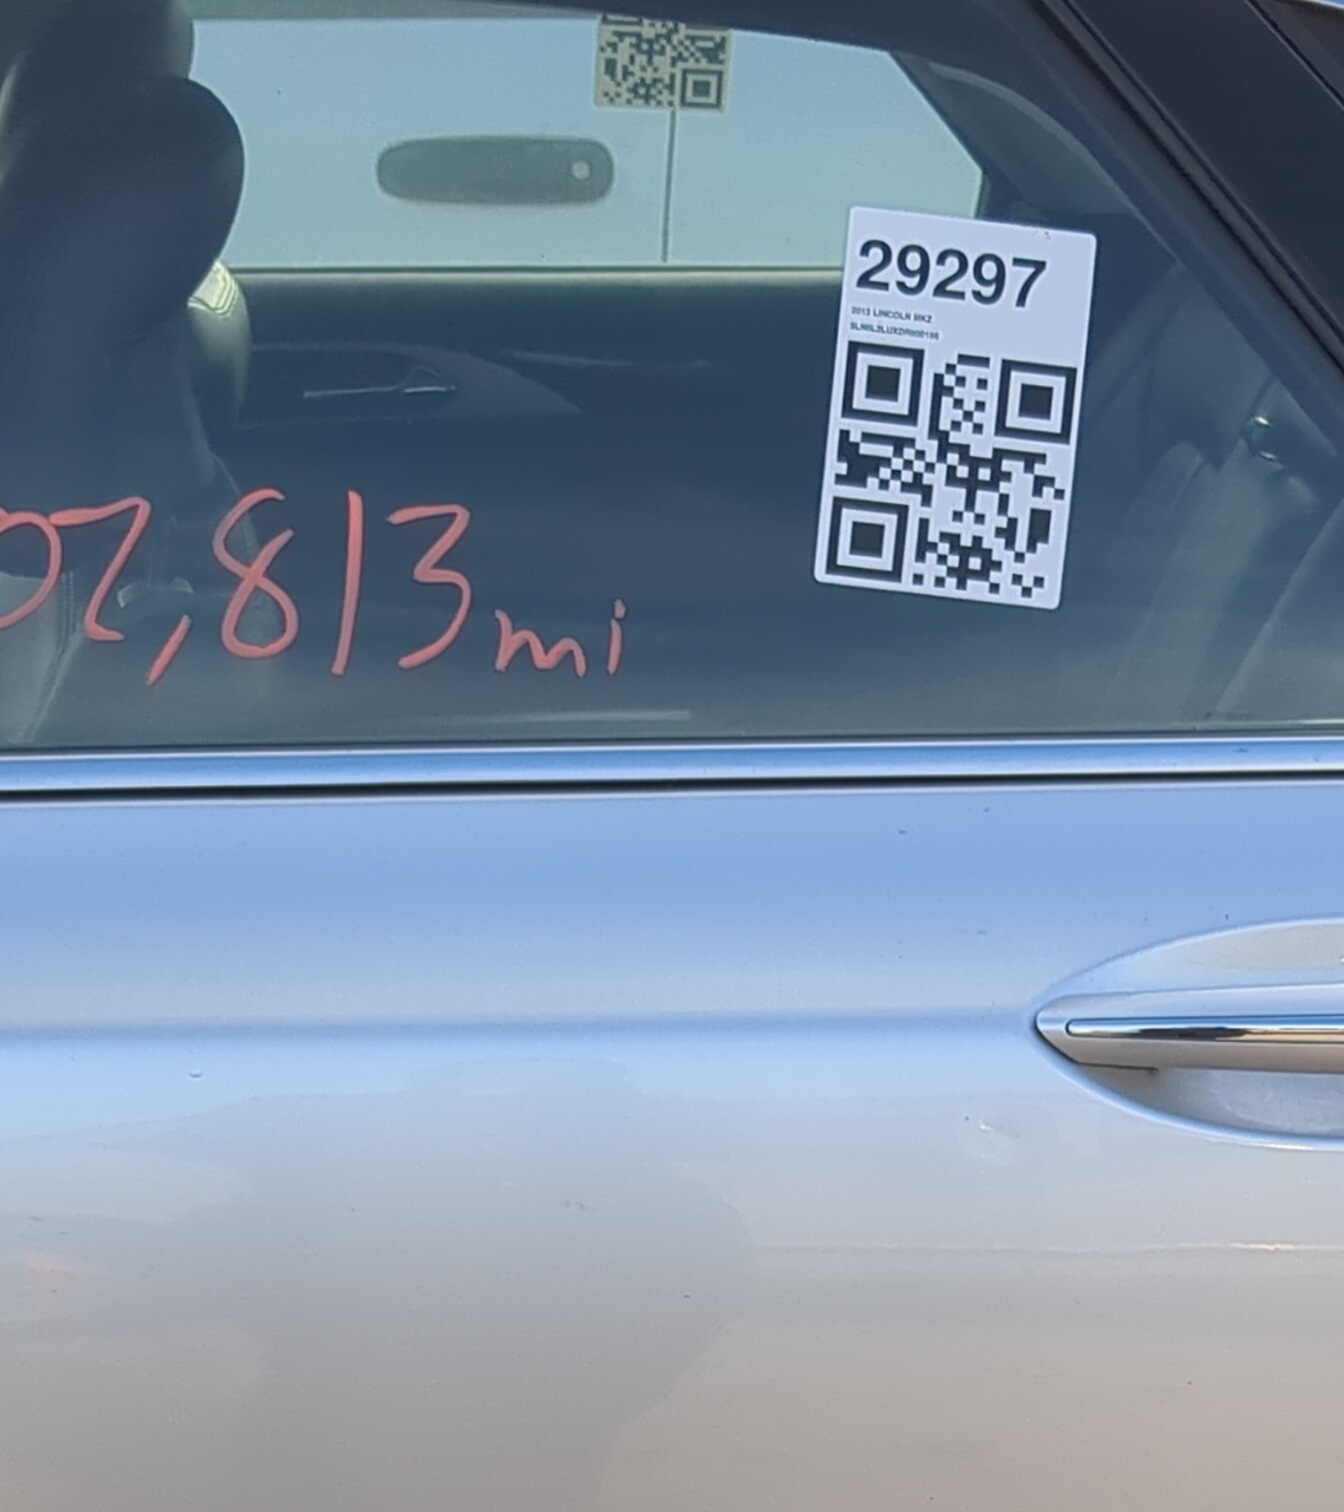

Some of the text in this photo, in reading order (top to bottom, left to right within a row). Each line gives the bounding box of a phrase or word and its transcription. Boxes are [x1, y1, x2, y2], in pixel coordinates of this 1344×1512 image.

[856, 239, 1047, 308] 29297
[873, 307, 911, 321] LINCOLN
[494, 599, 628, 679] mi
